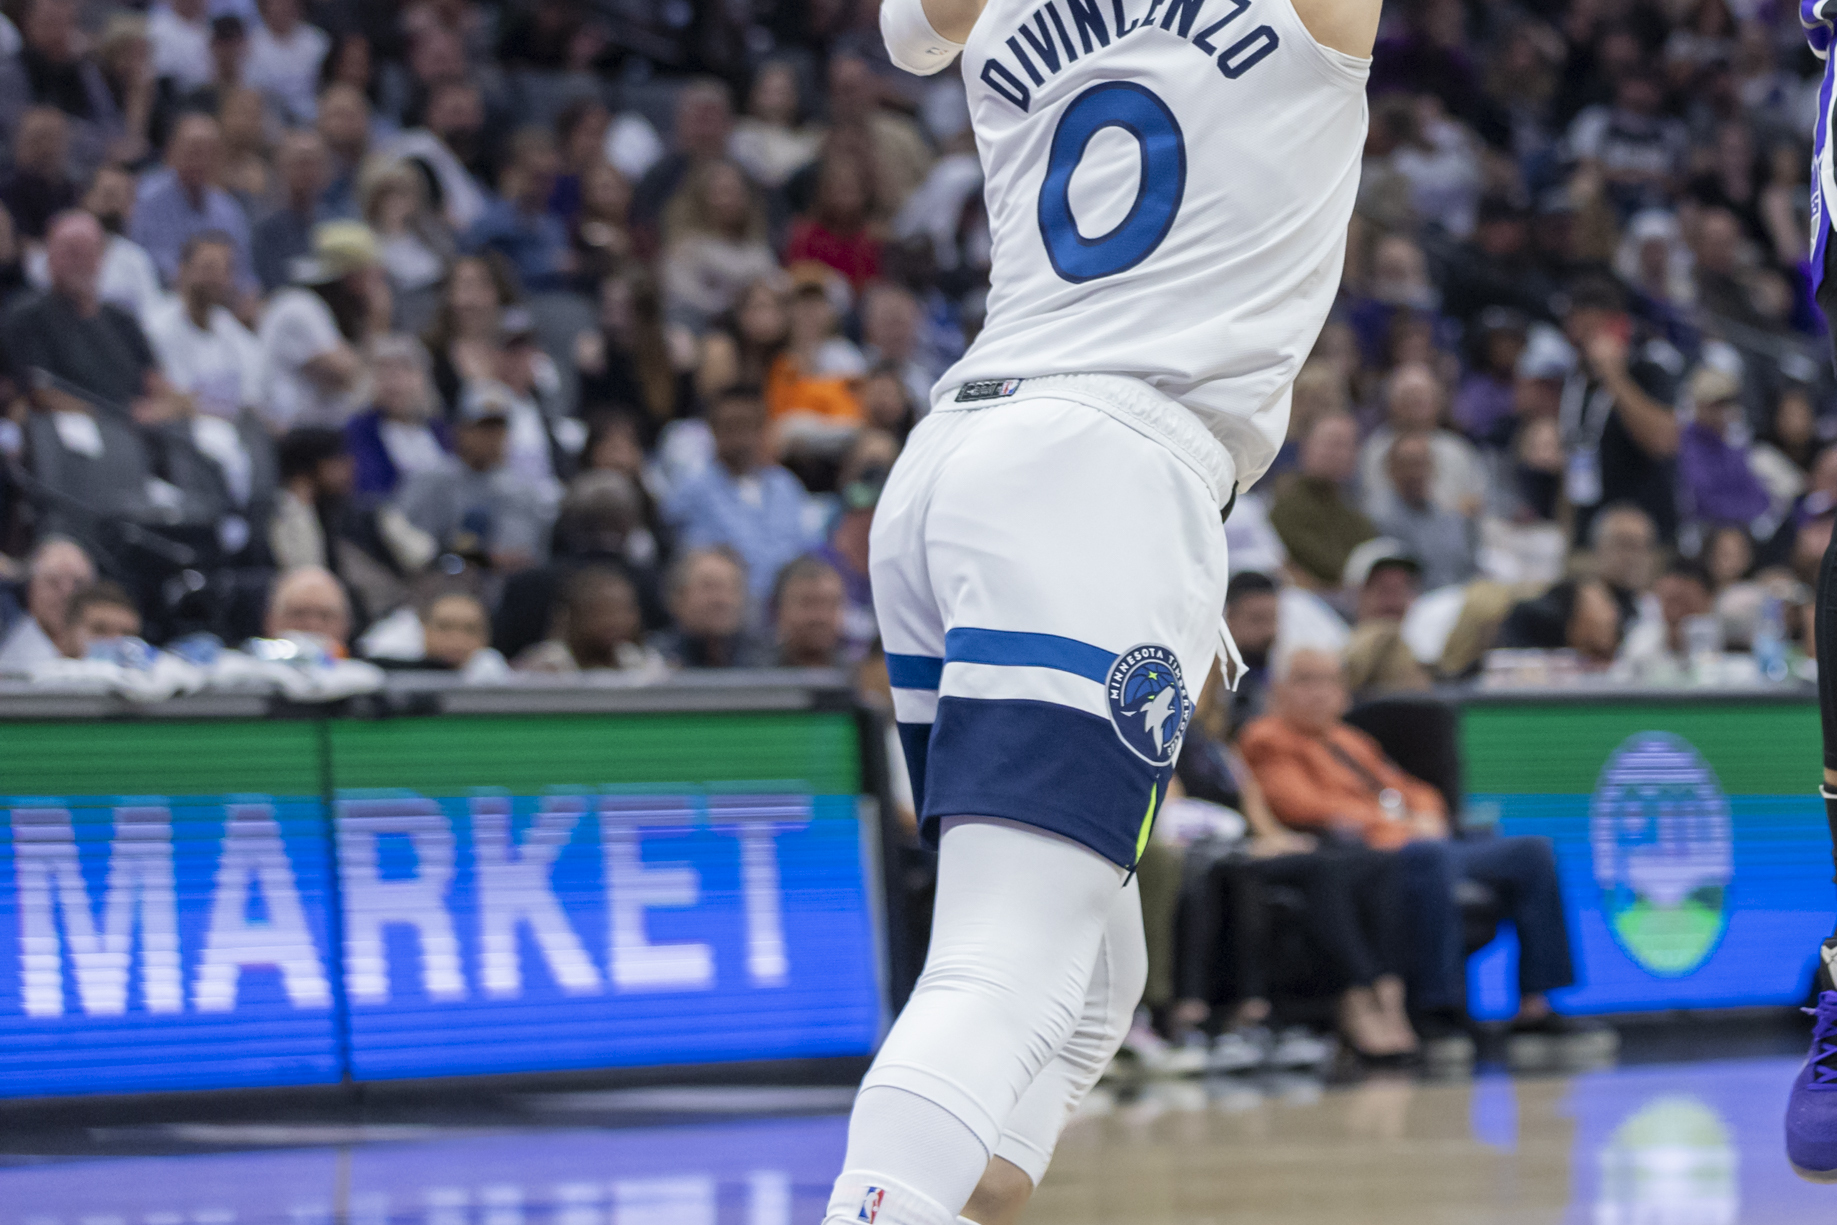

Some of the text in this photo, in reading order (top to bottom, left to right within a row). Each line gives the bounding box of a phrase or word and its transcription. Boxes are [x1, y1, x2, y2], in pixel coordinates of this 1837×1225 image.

[1038, 80, 1187, 284] 0
[1110, 648, 1164, 699] MINNESOTA
[10, 782, 812, 1016] MARKET
